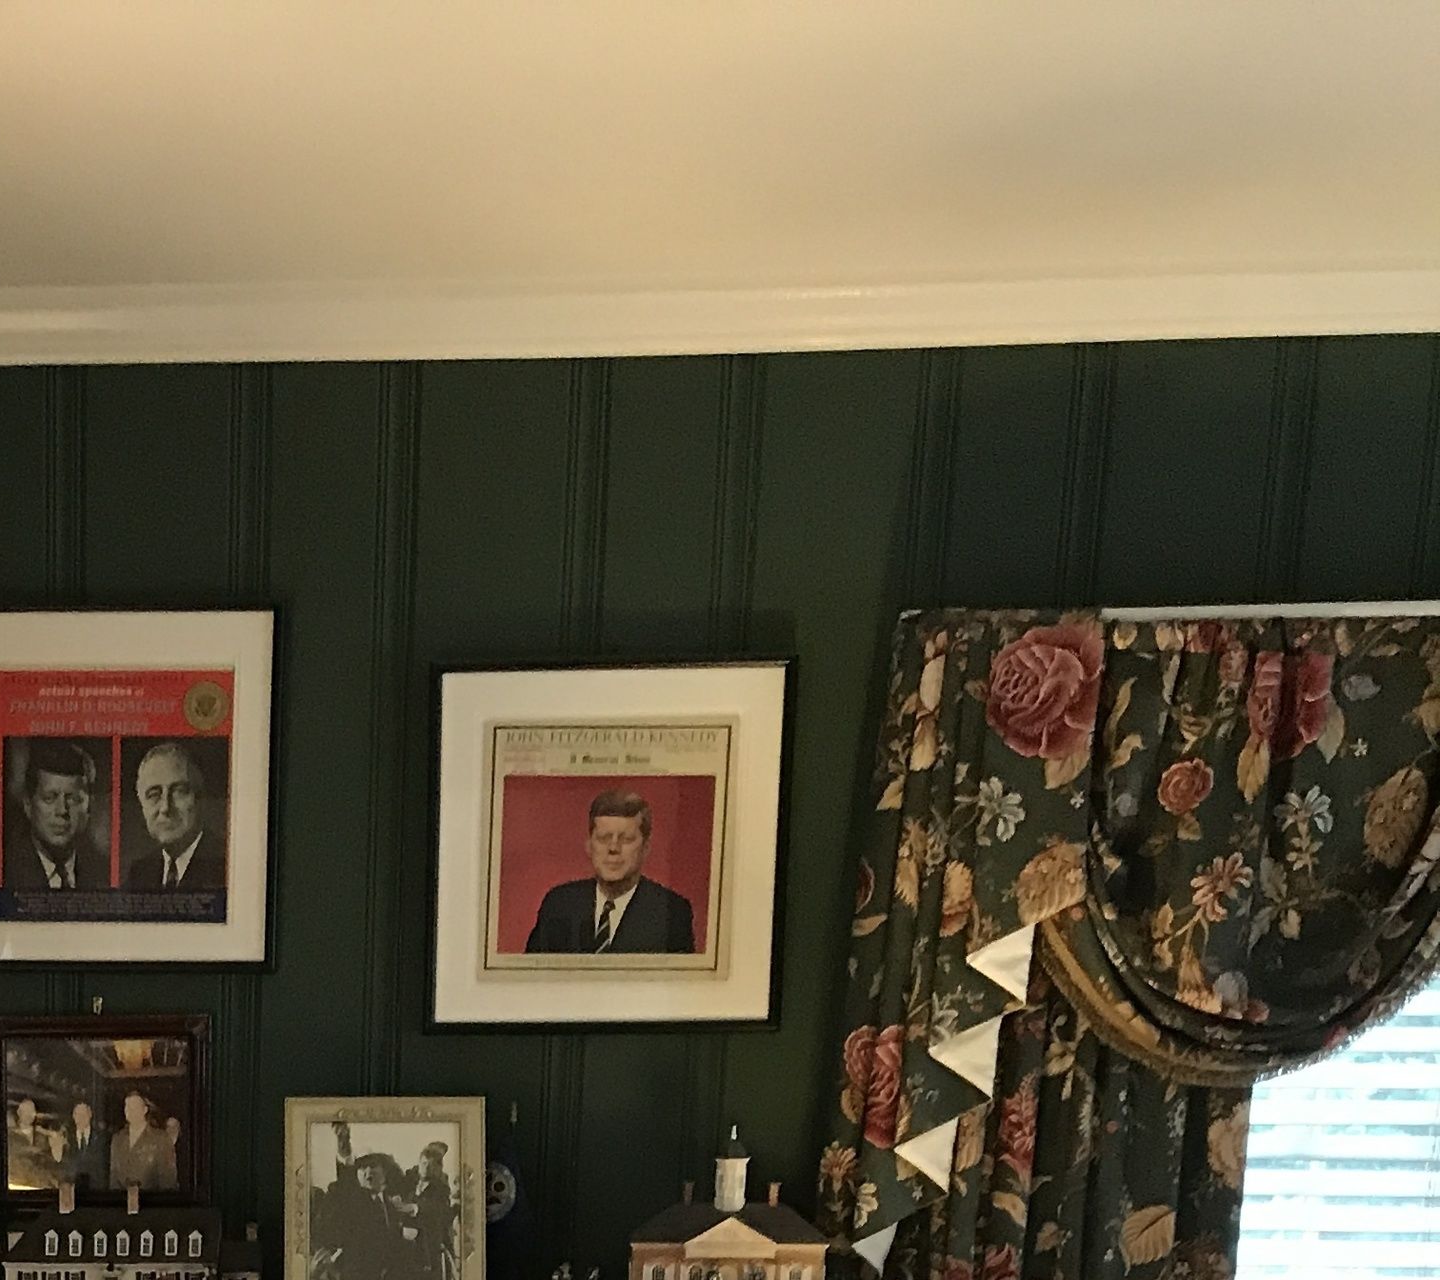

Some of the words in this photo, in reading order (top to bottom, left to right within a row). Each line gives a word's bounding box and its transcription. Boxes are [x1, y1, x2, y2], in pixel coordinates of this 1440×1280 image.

[505, 730, 545, 743] JOHN
[549, 730, 644, 743] FITZGERALD
[647, 730, 720, 743] KENNEDY
